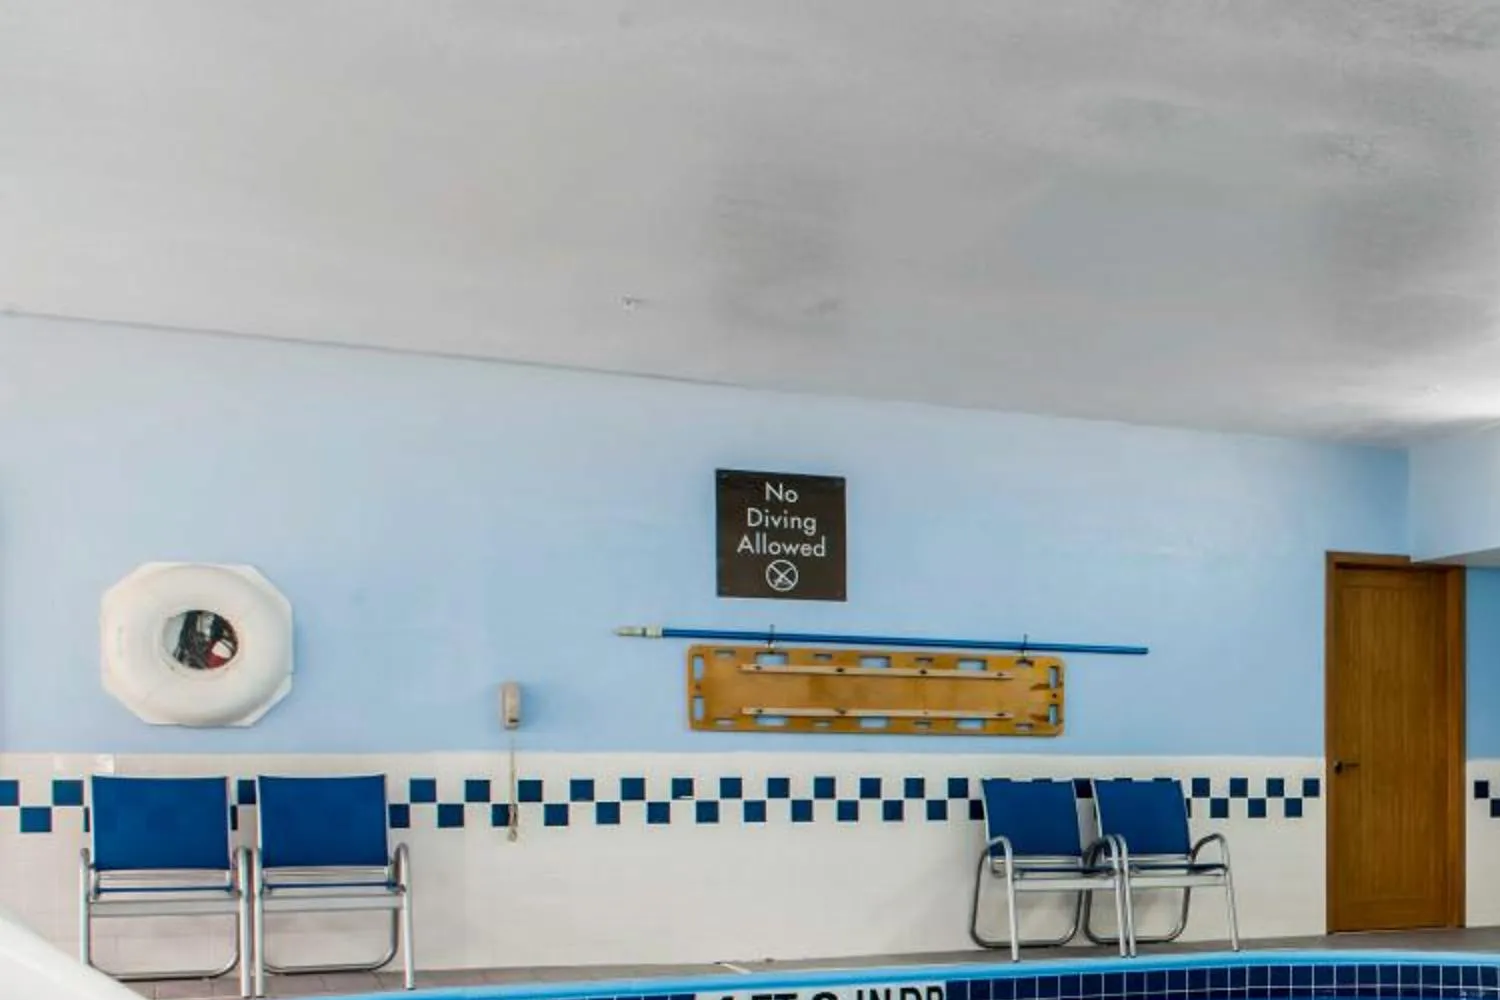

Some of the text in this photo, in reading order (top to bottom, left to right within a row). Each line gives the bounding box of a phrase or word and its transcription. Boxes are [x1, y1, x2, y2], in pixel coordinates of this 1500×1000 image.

[764, 481, 798, 503] No
[747, 507, 817, 536] Diving
[736, 532, 826, 557] Allowed
